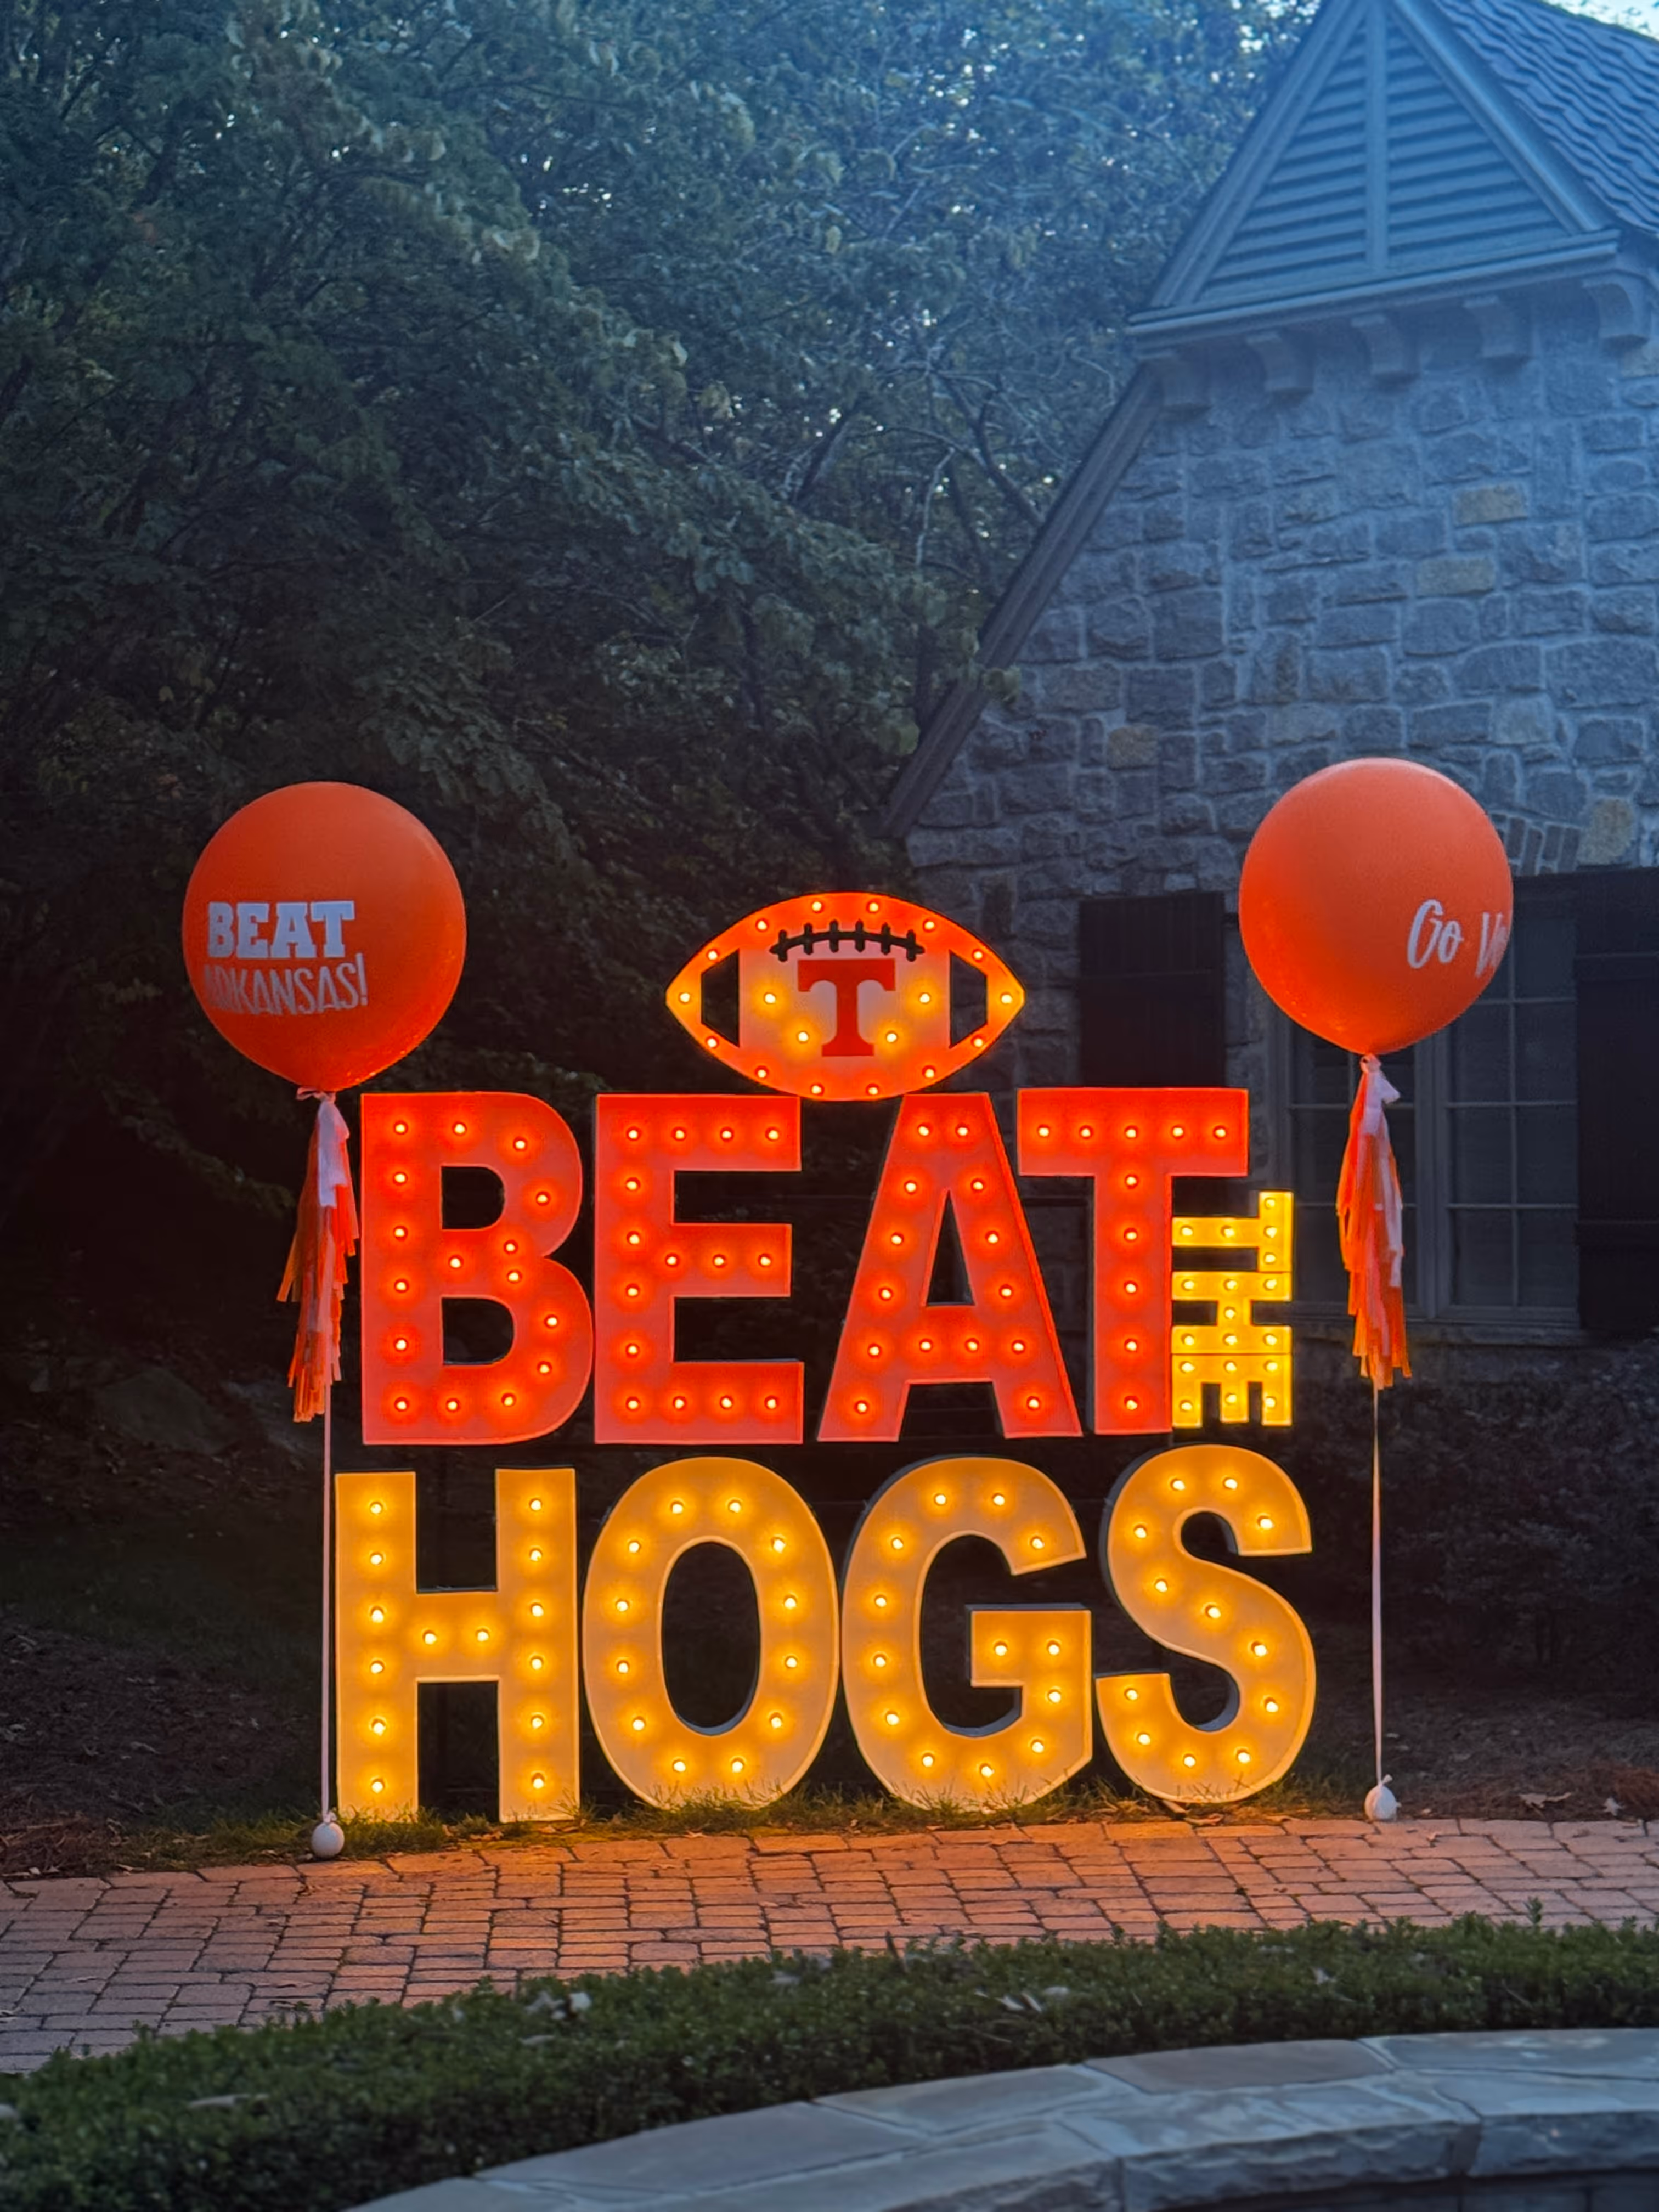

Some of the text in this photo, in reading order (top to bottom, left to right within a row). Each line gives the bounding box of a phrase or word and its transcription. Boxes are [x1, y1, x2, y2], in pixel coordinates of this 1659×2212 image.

[207, 900, 356, 959] BEAT
[1407, 898, 1464, 970] Go
[798, 958, 895, 1057] T
[360, 1088, 1294, 1446] BEAT THE
[334, 1444, 1317, 1824] HOGS
